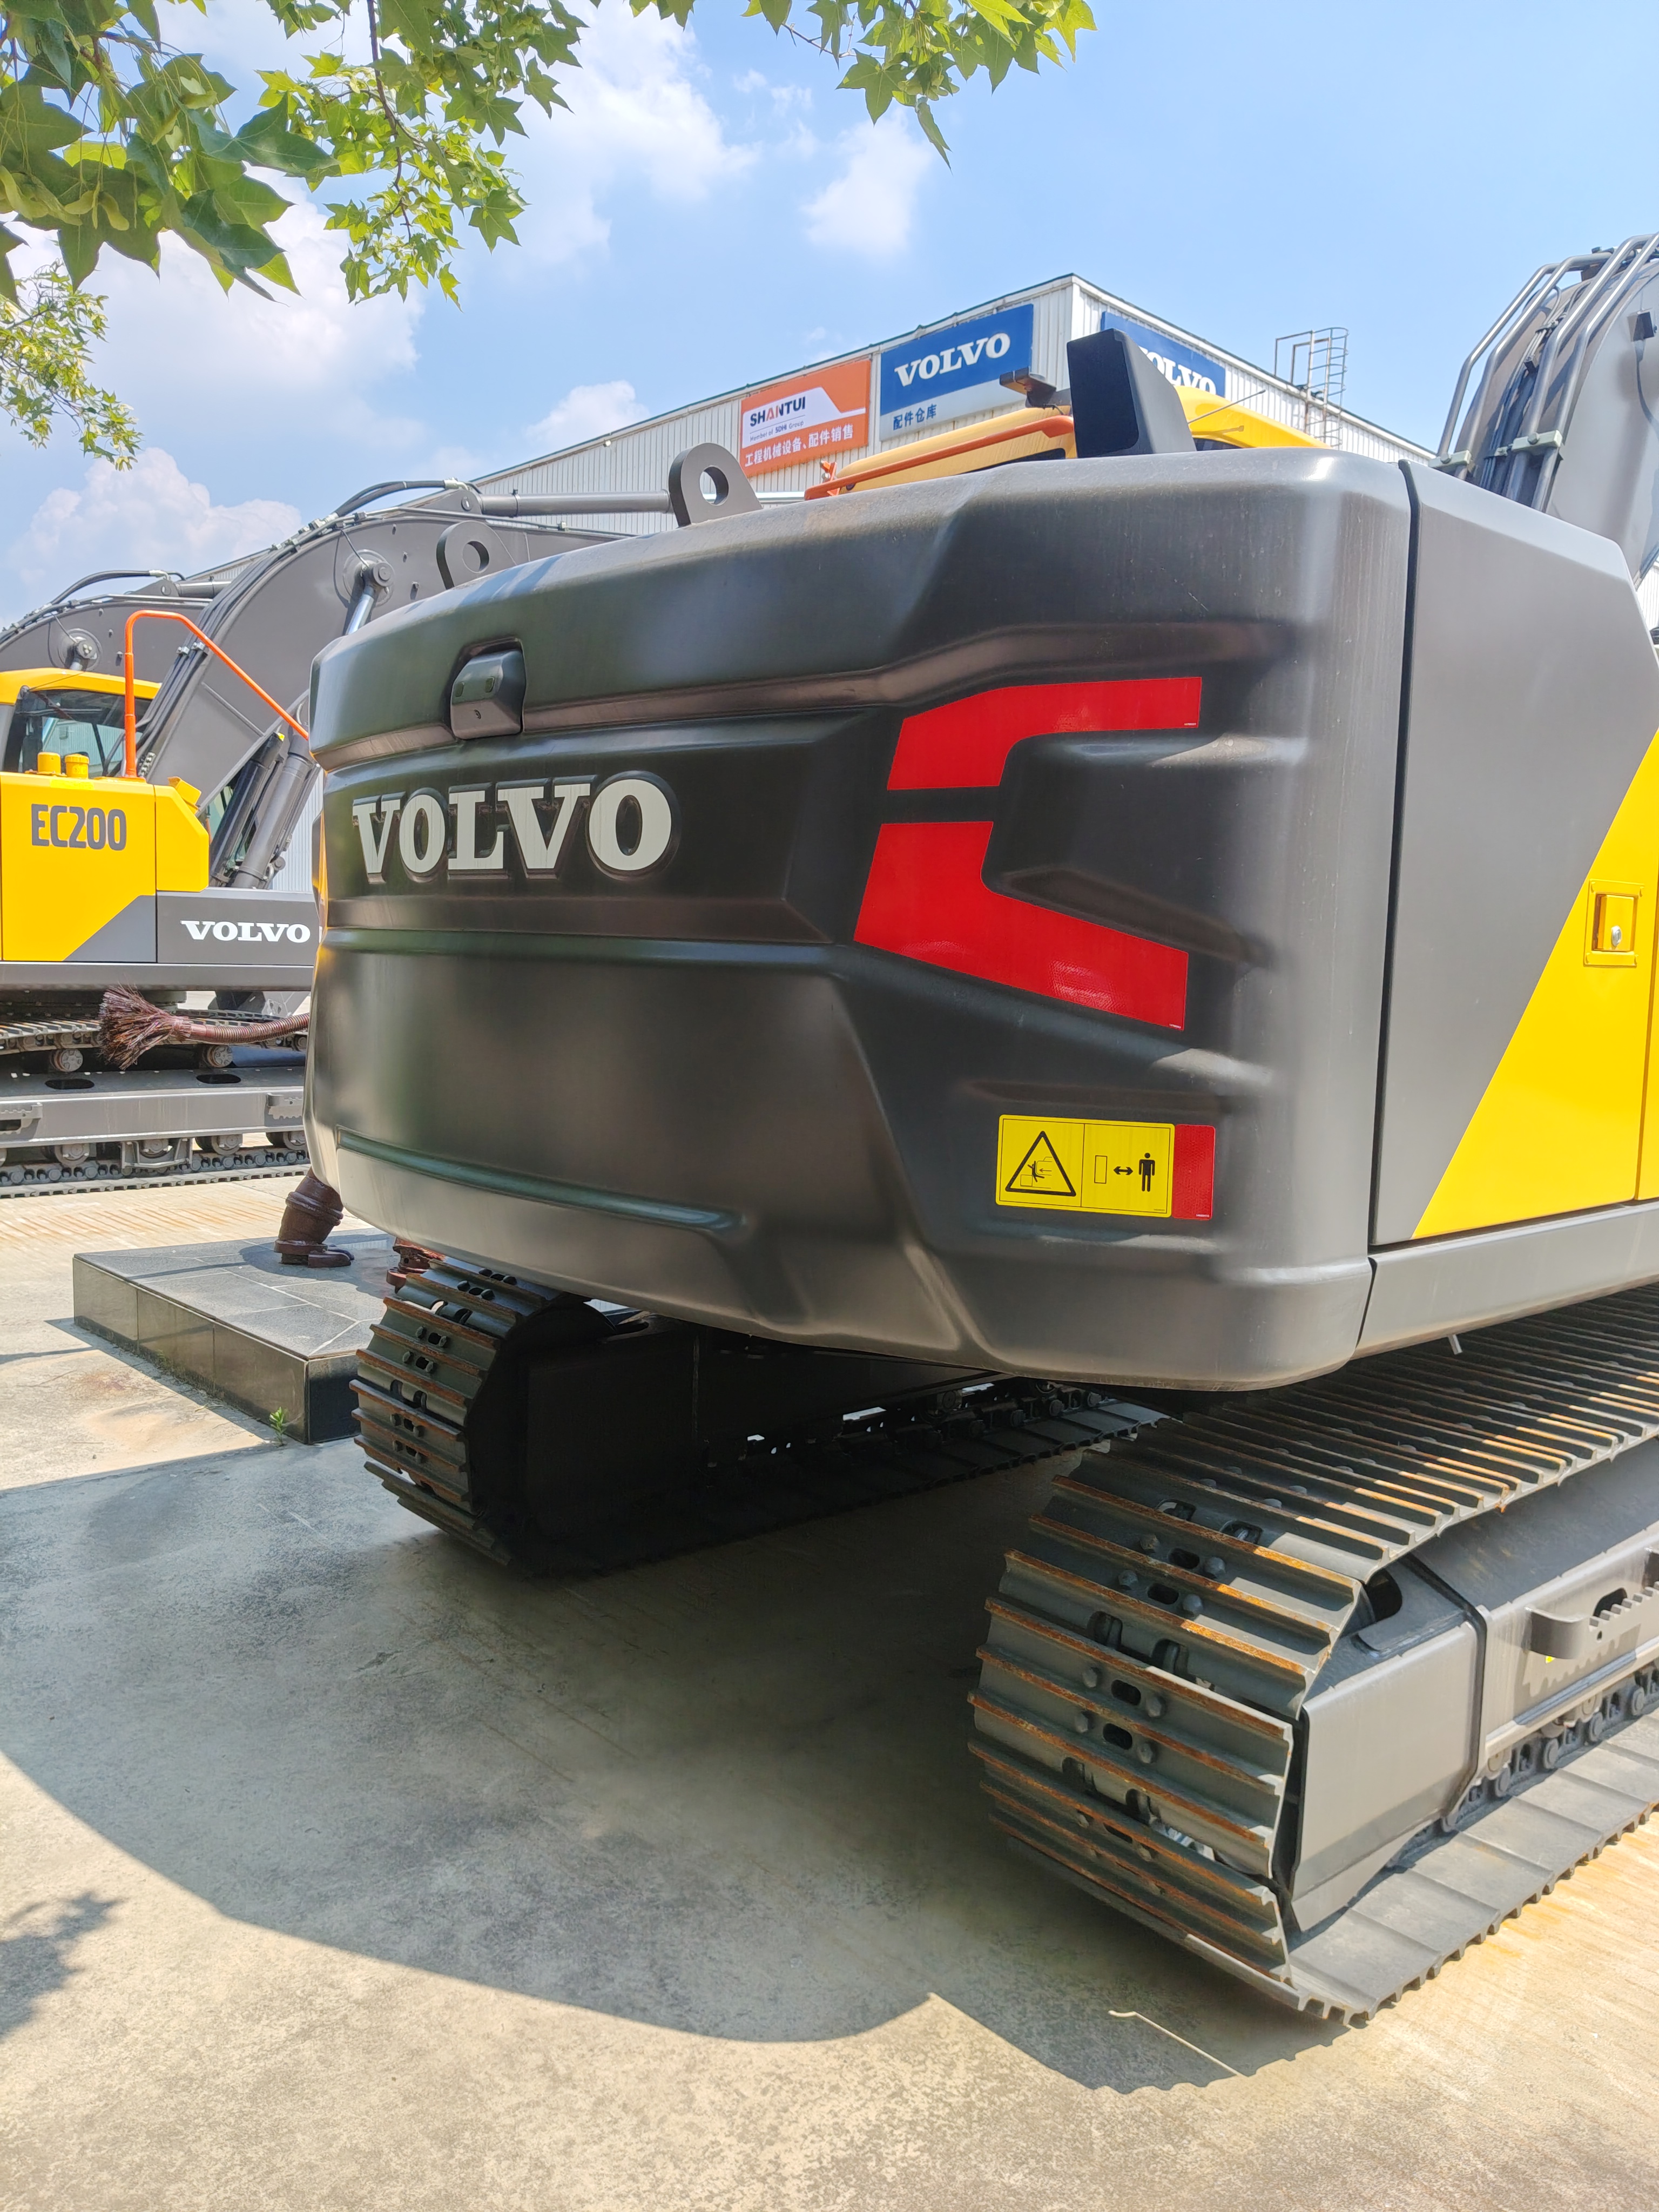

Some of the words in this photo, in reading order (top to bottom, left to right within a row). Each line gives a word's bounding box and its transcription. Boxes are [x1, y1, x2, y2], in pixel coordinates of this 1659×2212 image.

[894, 332, 1011, 387] VOLVO
[1138, 346, 1217, 395] OLVO
[750, 396, 806, 427] SHANTUI
[750, 431, 767, 442] Member
[768, 428, 773, 436] of
[788, 421, 804, 429] Group
[893, 404, 937, 431] 配件仓库
[744, 423, 854, 468] 工程机械设备、配件销售
[31, 803, 127, 851] EC200
[352, 778, 672, 874] VOLVO
[181, 920, 311, 943] VOLVO
